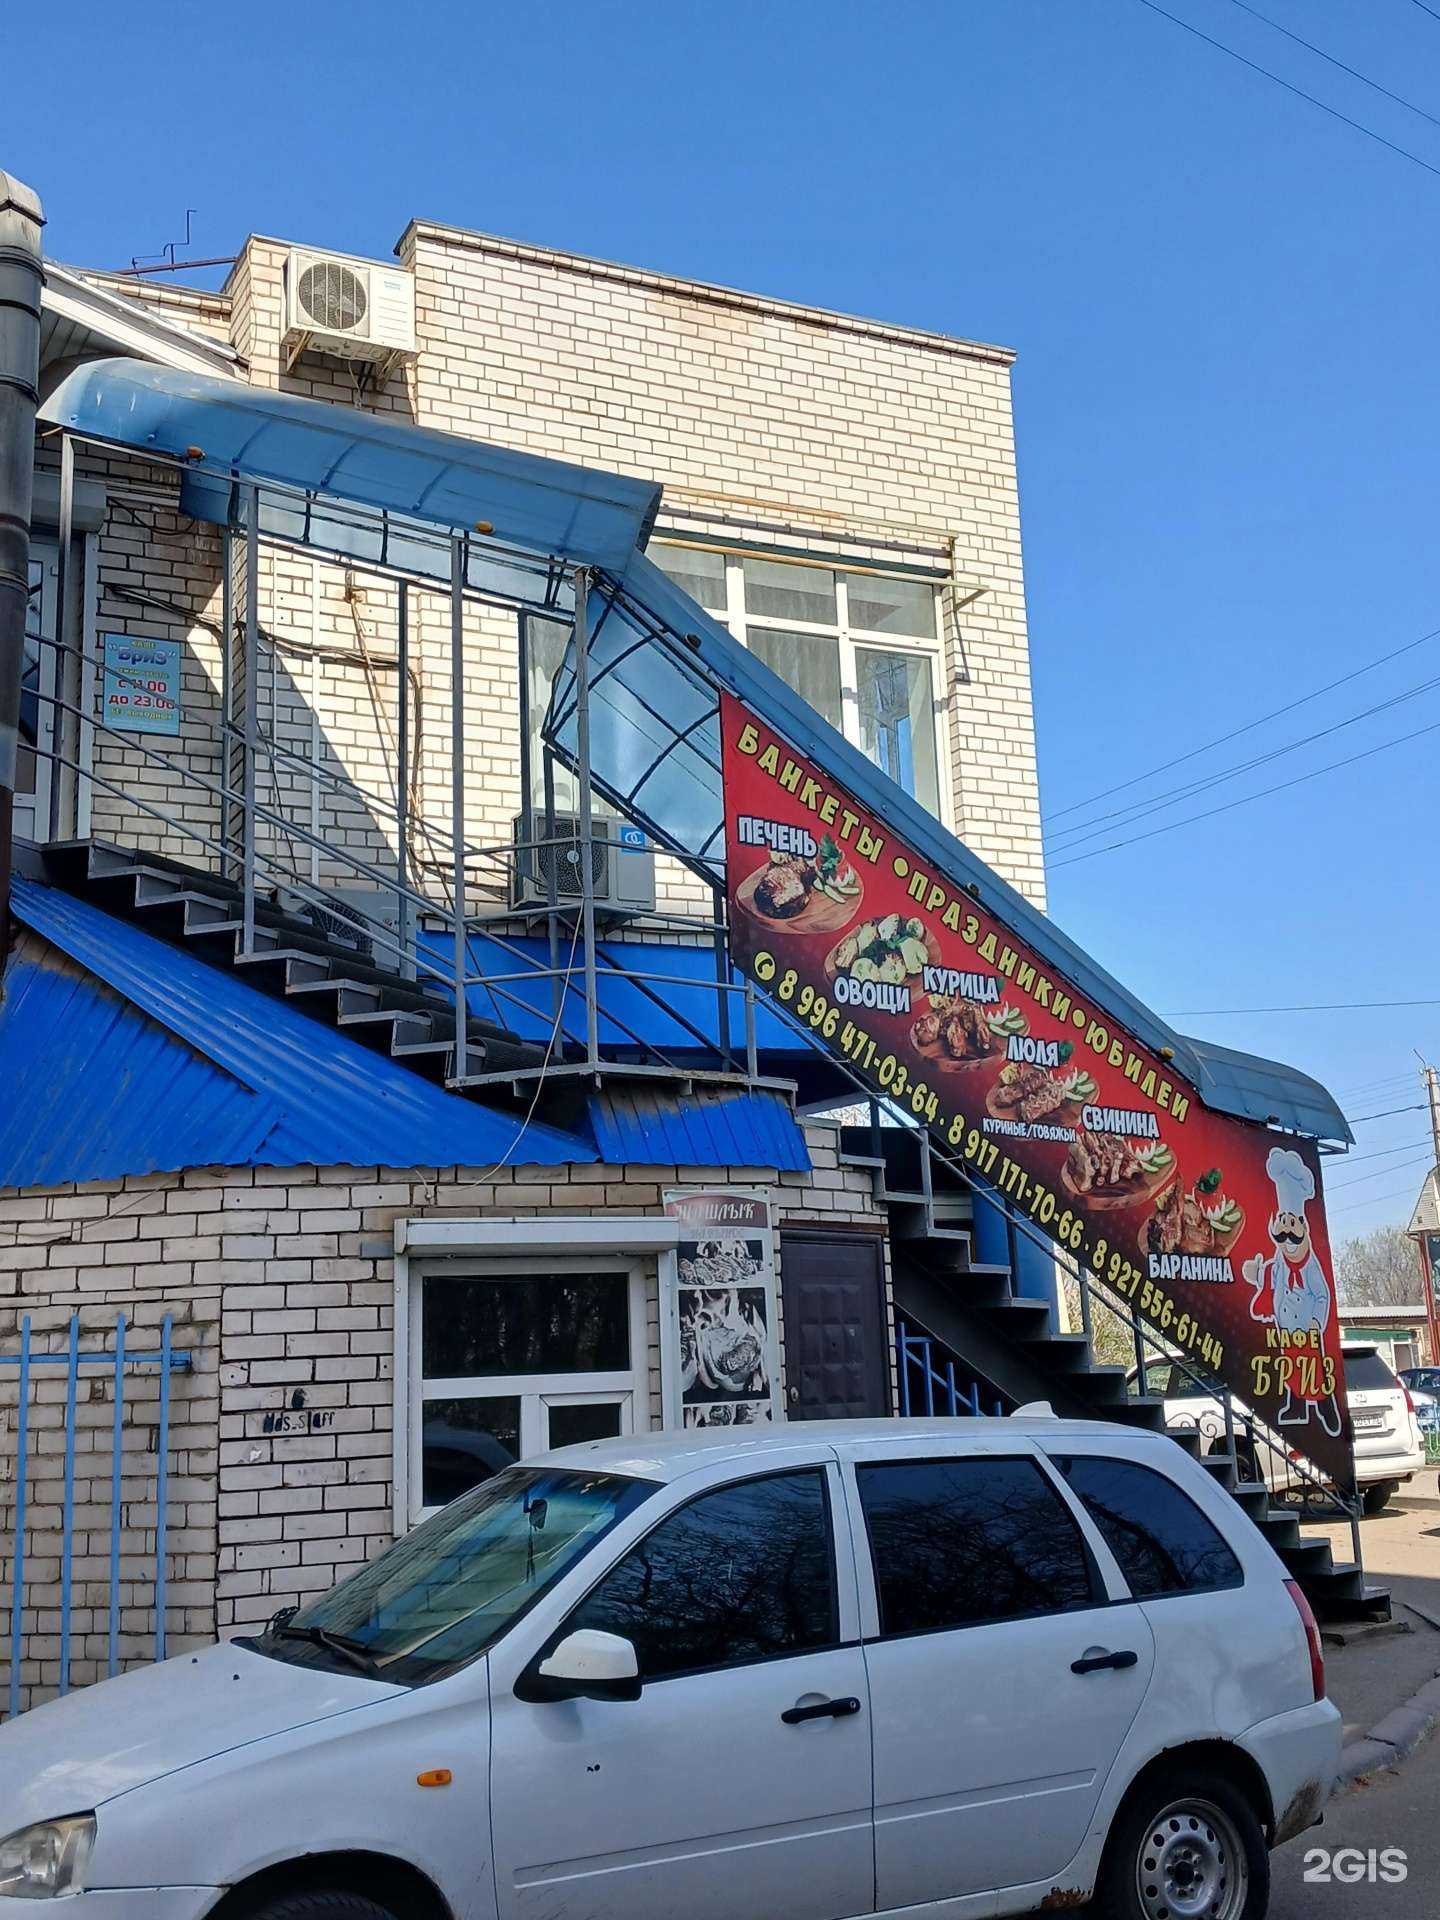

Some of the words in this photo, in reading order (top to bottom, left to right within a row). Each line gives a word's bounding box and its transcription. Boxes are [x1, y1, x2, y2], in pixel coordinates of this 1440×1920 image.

[737, 816, 819, 858] ПЕЧЕНЬ
[737, 723, 886, 865] БАНКЕТЫ
[907, 870, 1073, 1023] ПРАЗДНИКИ
[833, 976, 912, 1015] ОВОЩИ
[922, 965, 1000, 1004] КУРИЦА
[1007, 1035, 1060, 1068] ЛЮЛЯ
[1081, 1104, 1160, 1139] СВИНИНА
[778, 969, 799, 1000] 8
[797, 985, 841, 1038] 996
[840, 1021, 940, 1122] 471-03-64
[948, 1114, 965, 1145] 8
[964, 1129, 1000, 1174] 917
[998, 1157, 1084, 1249] 171-70-66
[1092, 1239, 1108, 1269] 8
[1107, 1252, 1143, 1298] 927
[1140, 1280, 1224, 1371] 556-61-44
[1148, 1253, 1235, 1283] БАРАНИНА
[1265, 1328, 1320, 1349] КАФЕ
[1251, 1355, 1336, 1397] БРИЗ
